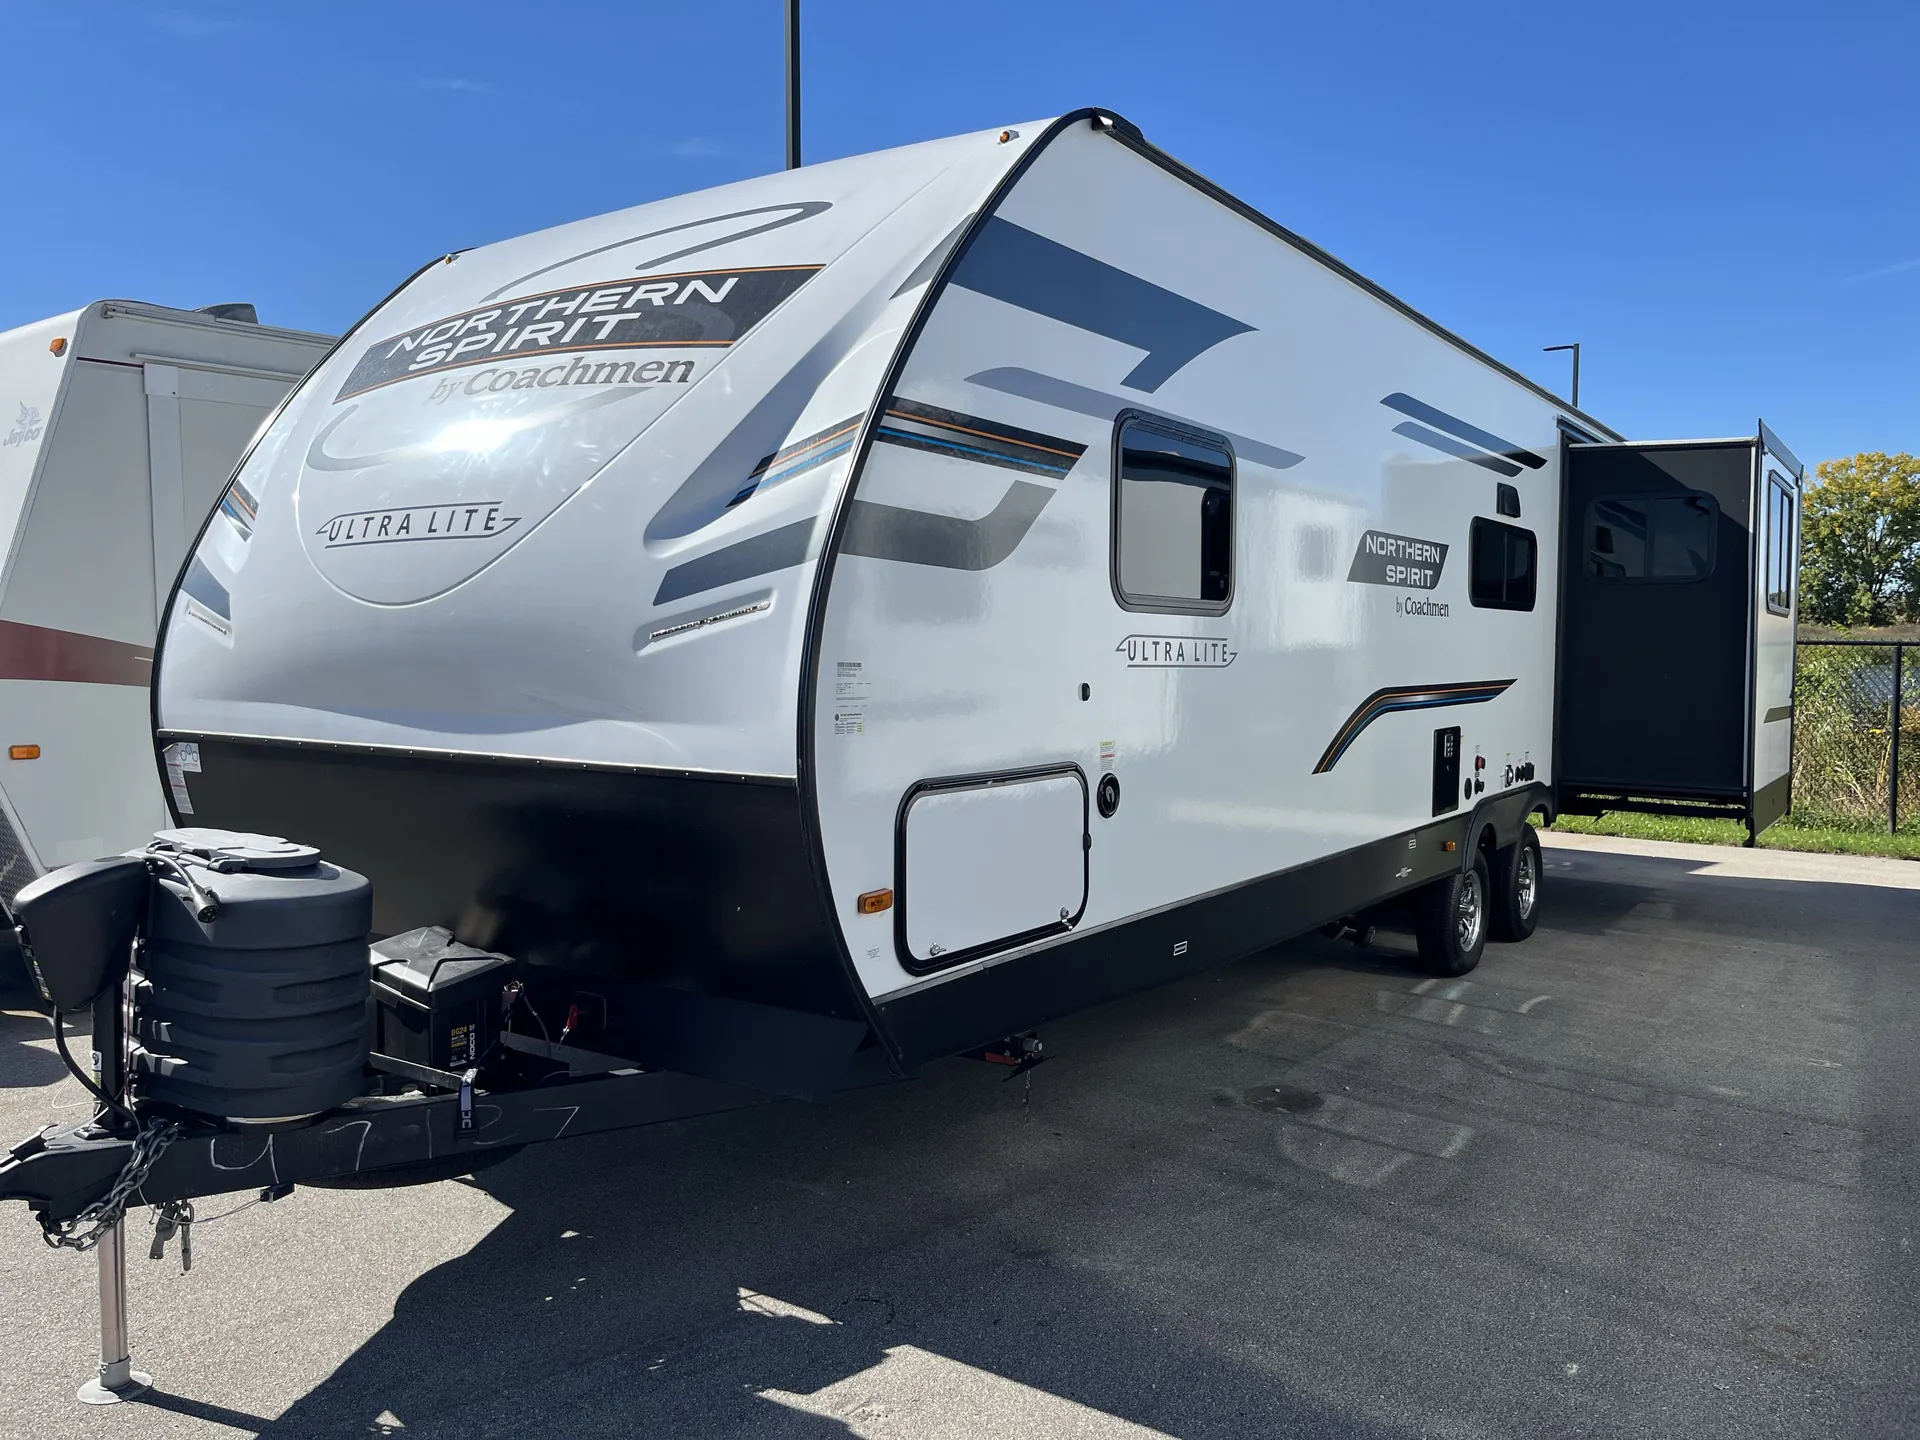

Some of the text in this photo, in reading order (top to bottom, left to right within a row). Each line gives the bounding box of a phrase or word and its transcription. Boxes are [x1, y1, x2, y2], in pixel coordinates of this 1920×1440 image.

[385, 277, 739, 359] NORTHERN
[408, 312, 641, 371] SPIRIT
[431, 356, 695, 403] by Coachmen
[328, 508, 499, 541] ULTRA LITE
[1366, 534, 1440, 563] NORTHERN
[1386, 564, 1433, 587] SPIRIT
[1396, 596, 1449, 618] by Coachmen
[1128, 640, 1227, 662] ULTRA LITE
